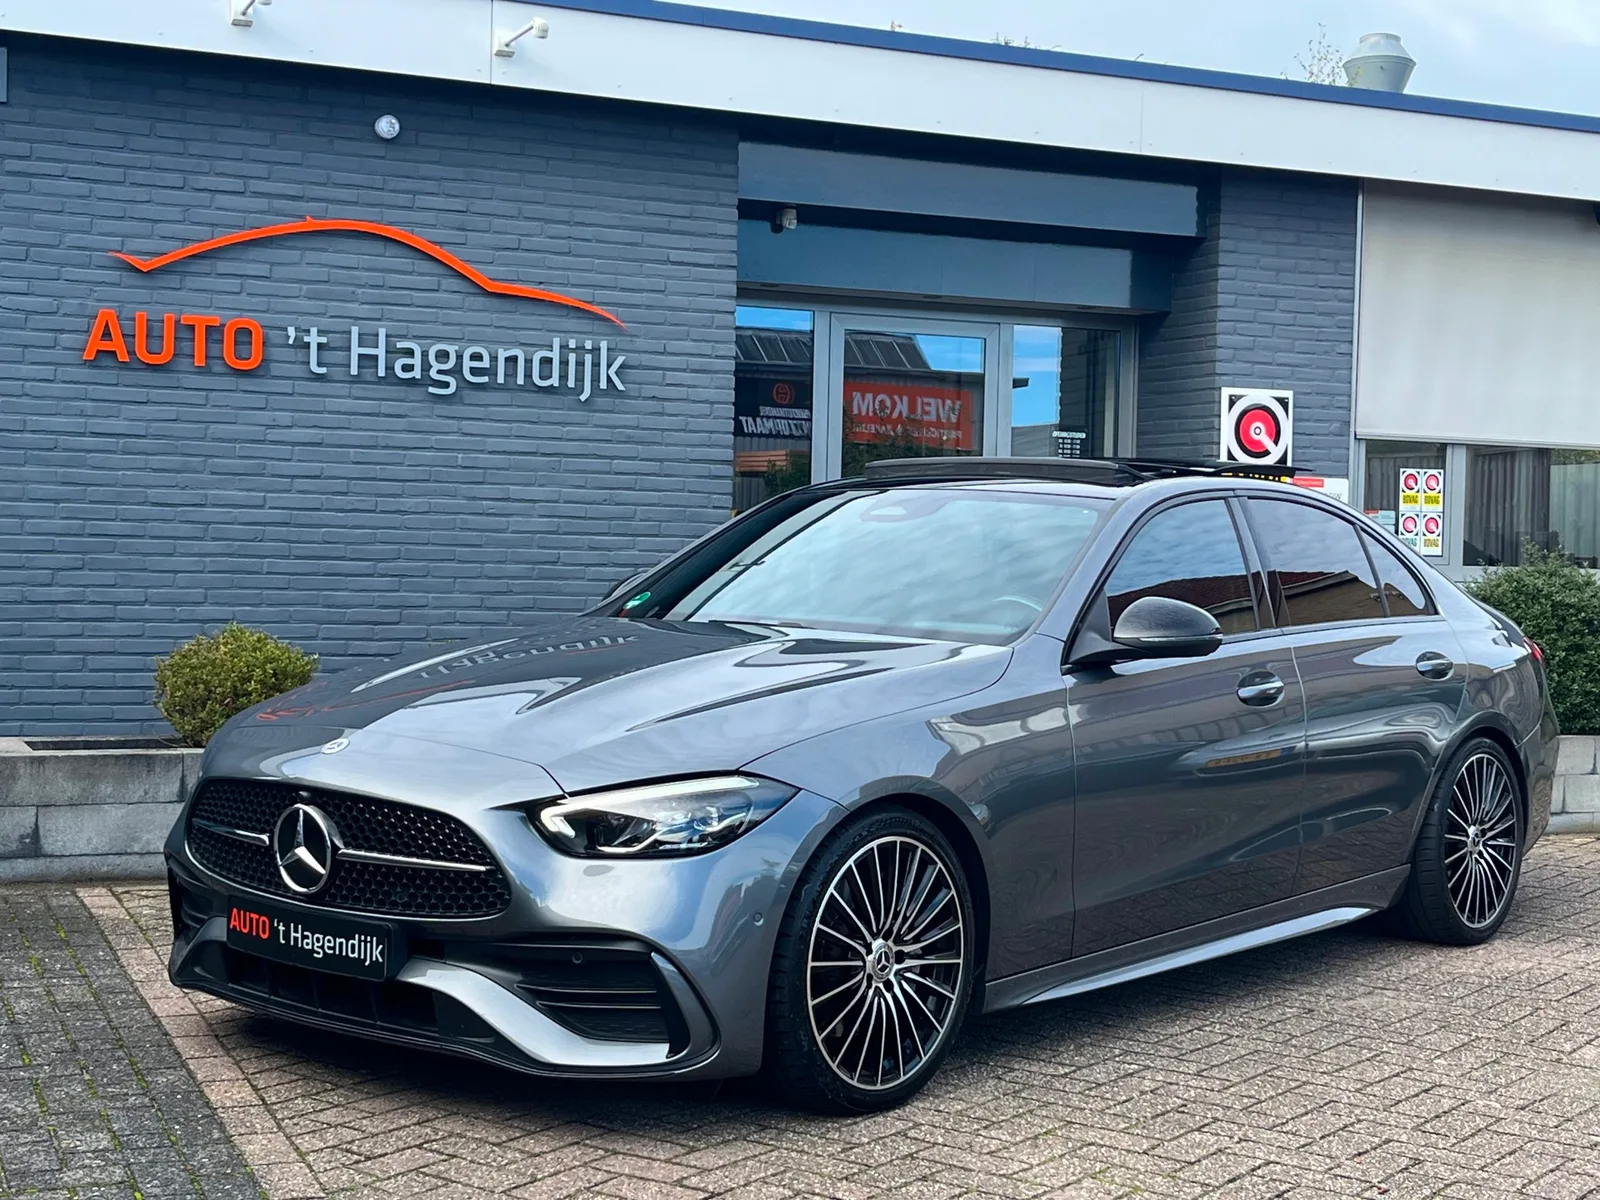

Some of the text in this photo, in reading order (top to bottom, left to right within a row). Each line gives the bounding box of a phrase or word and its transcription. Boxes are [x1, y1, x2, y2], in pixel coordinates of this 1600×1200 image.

[83, 309, 626, 402] AUTO 't Hagendijk
[1402, 494, 1419, 504] BOVAG
[1424, 495, 1440, 504] BOVAG
[1423, 538, 1439, 548] BOVAG
[230, 907, 384, 966] AUTO 't Hagendijk
